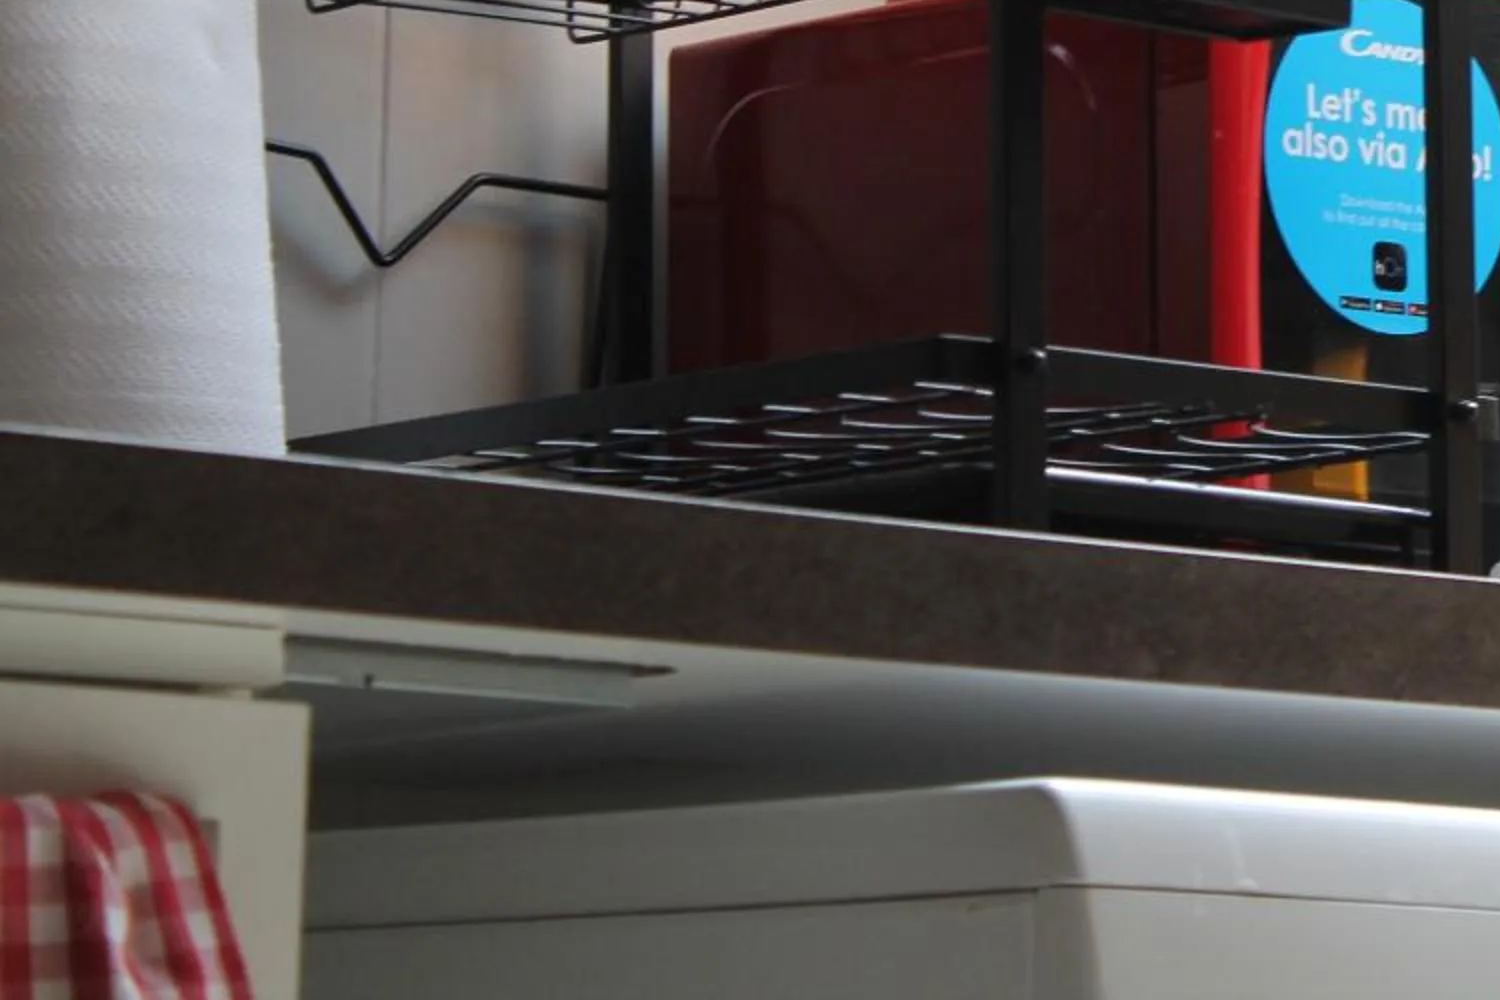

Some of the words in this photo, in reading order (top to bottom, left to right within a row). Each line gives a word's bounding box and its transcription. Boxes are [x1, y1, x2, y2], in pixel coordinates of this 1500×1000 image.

[1306, 82, 1377, 127] Let's
[1282, 121, 1349, 163] also
[1357, 131, 1407, 170] via
